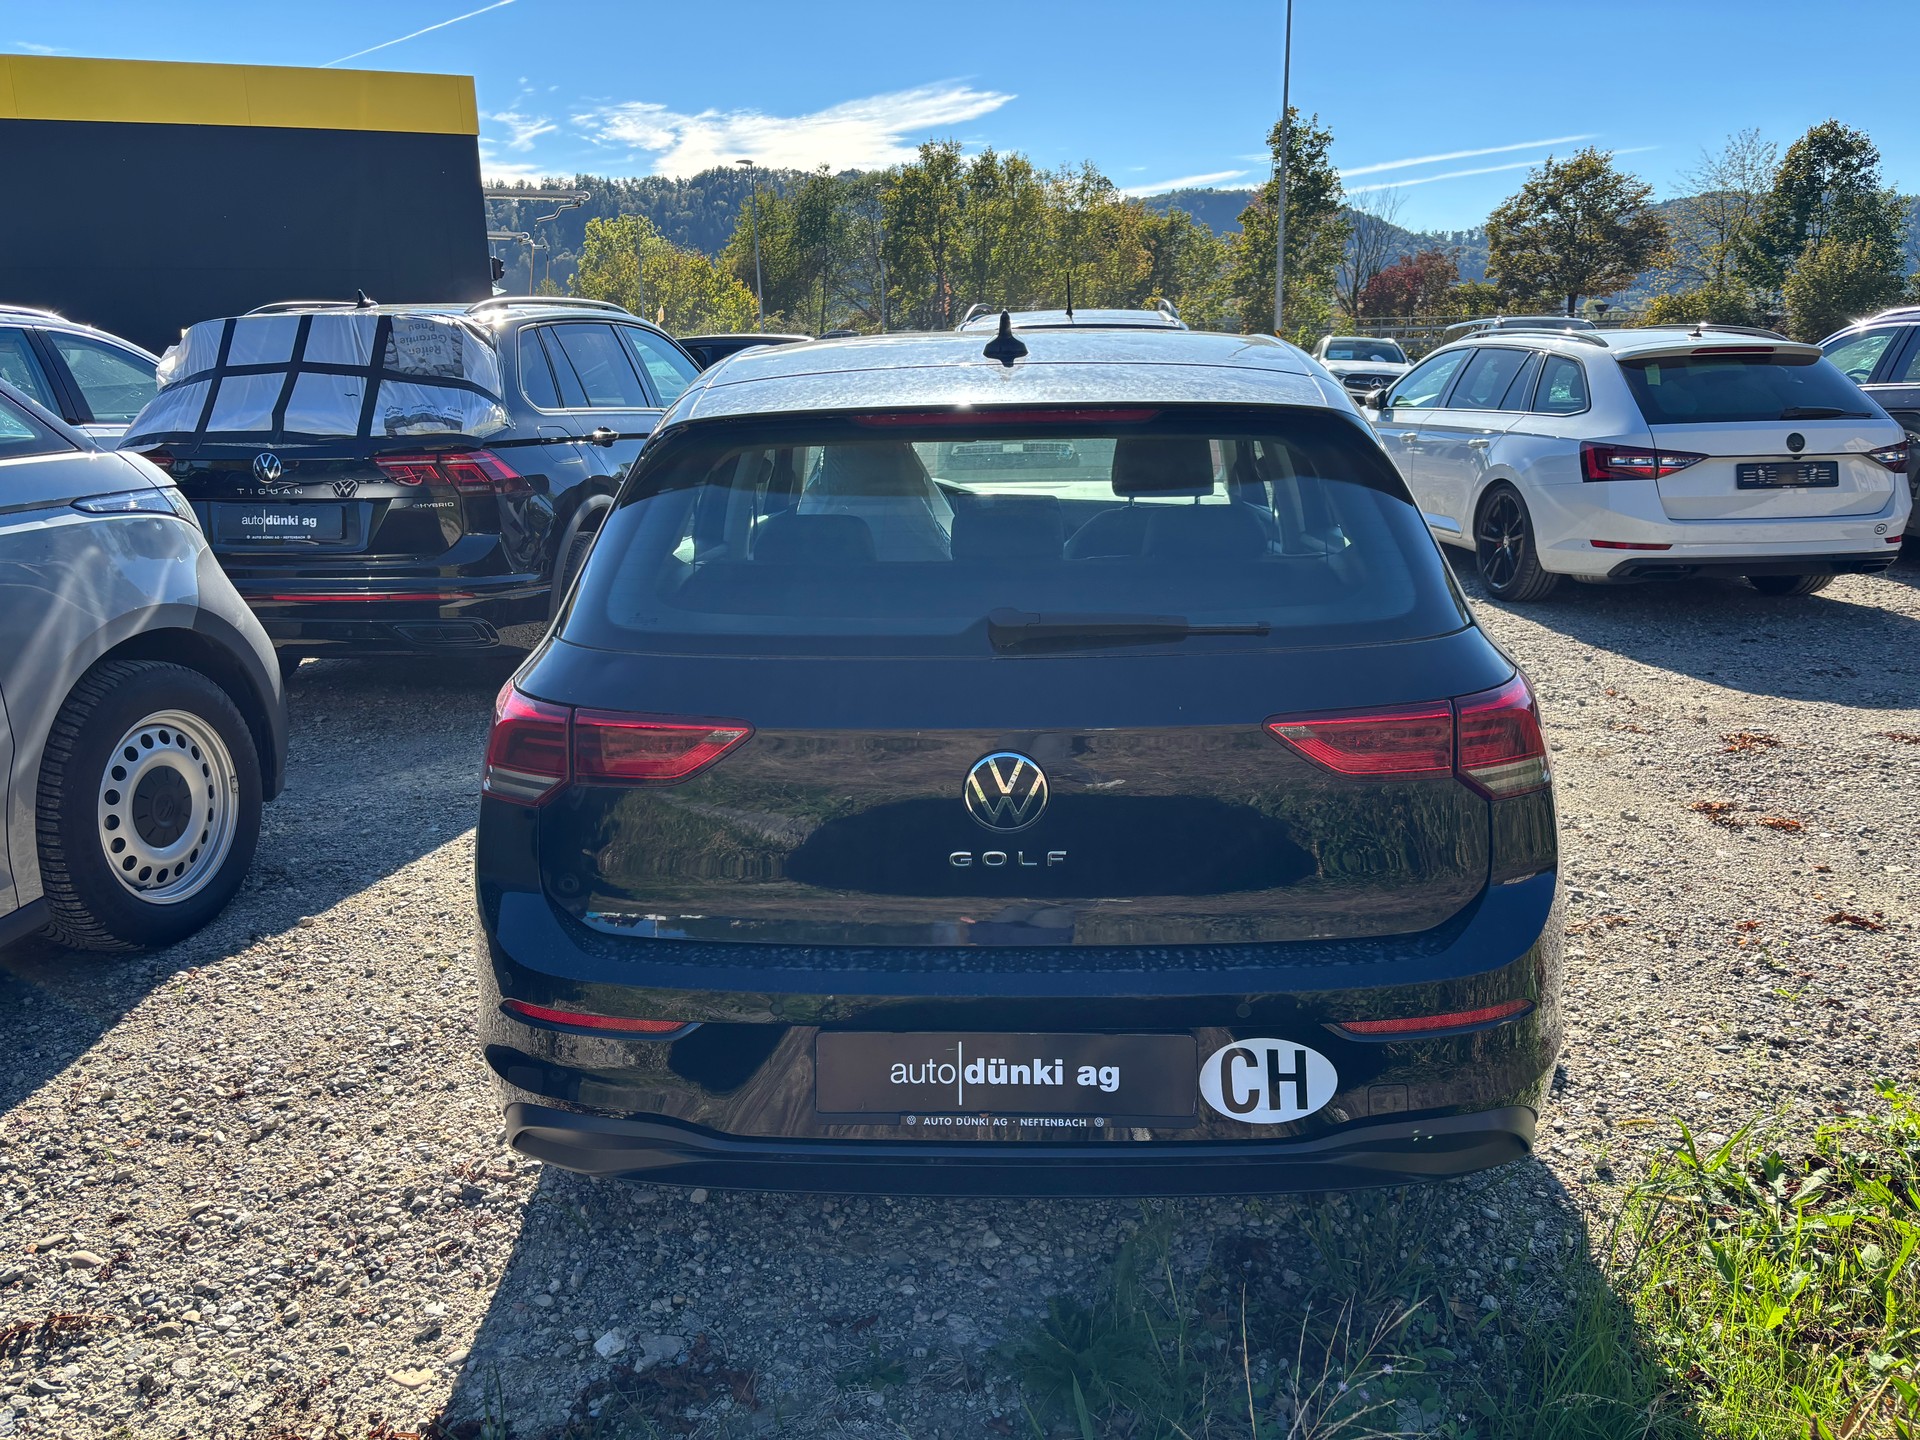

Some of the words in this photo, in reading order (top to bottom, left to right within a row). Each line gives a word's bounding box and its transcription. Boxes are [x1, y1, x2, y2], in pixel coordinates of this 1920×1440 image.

[408, 322, 436, 332] Pneu
[400, 333, 447, 345] Garantie
[412, 501, 454, 509] eHYBRID
[265, 515, 299, 526] dünki
[302, 517, 317, 528] ag
[948, 850, 1068, 867] GOLF
[890, 1058, 957, 1085] auto
[964, 1057, 1063, 1086] dünki
[1076, 1065, 1120, 1093] ag
[1220, 1047, 1309, 1114] CH
[923, 1117, 952, 1126] AUTO
[956, 1115, 989, 1126] DÜNKI
[993, 1117, 1008, 1127] AG
[1020, 1117, 1087, 1127] NEFTENBACH
